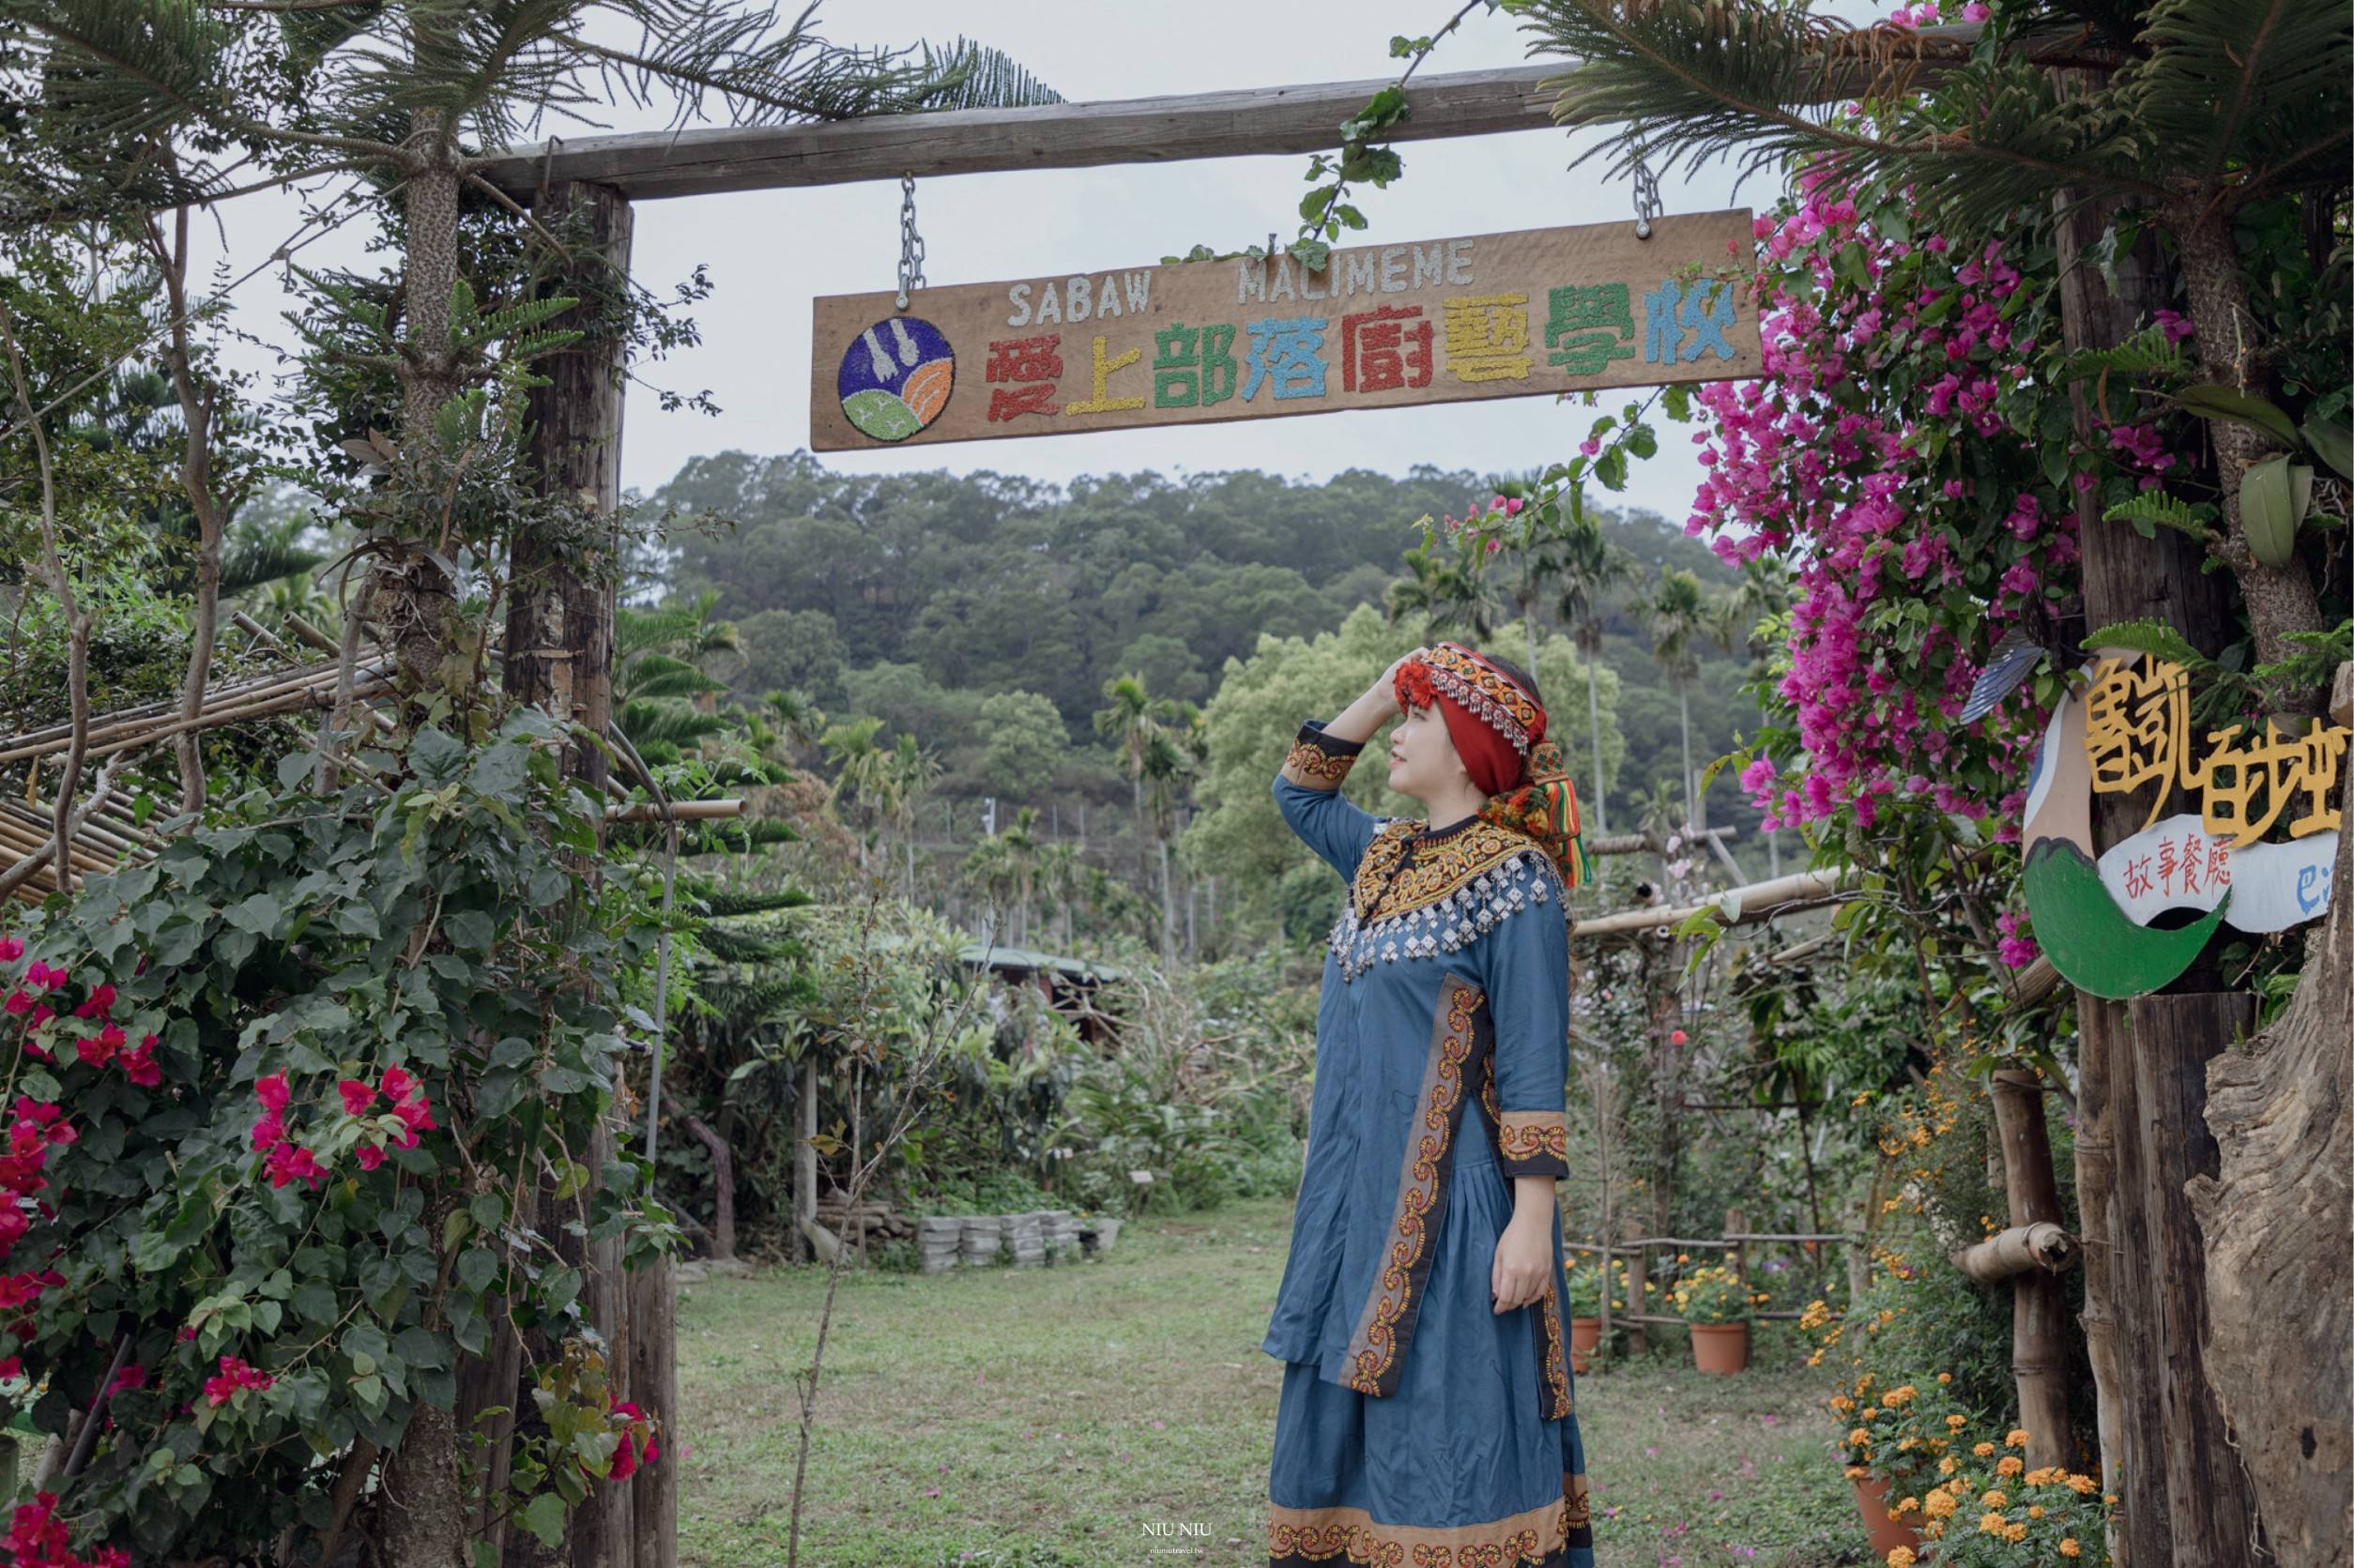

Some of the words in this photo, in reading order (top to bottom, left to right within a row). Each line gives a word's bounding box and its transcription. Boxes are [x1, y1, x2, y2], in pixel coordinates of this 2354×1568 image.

[1006, 269, 1153, 327] SABAW
[1237, 238, 1475, 305] MALIMEME
[986, 278, 1737, 422] 愛上部落廚藝學校
[2123, 832, 2233, 900] 故事餐廳
